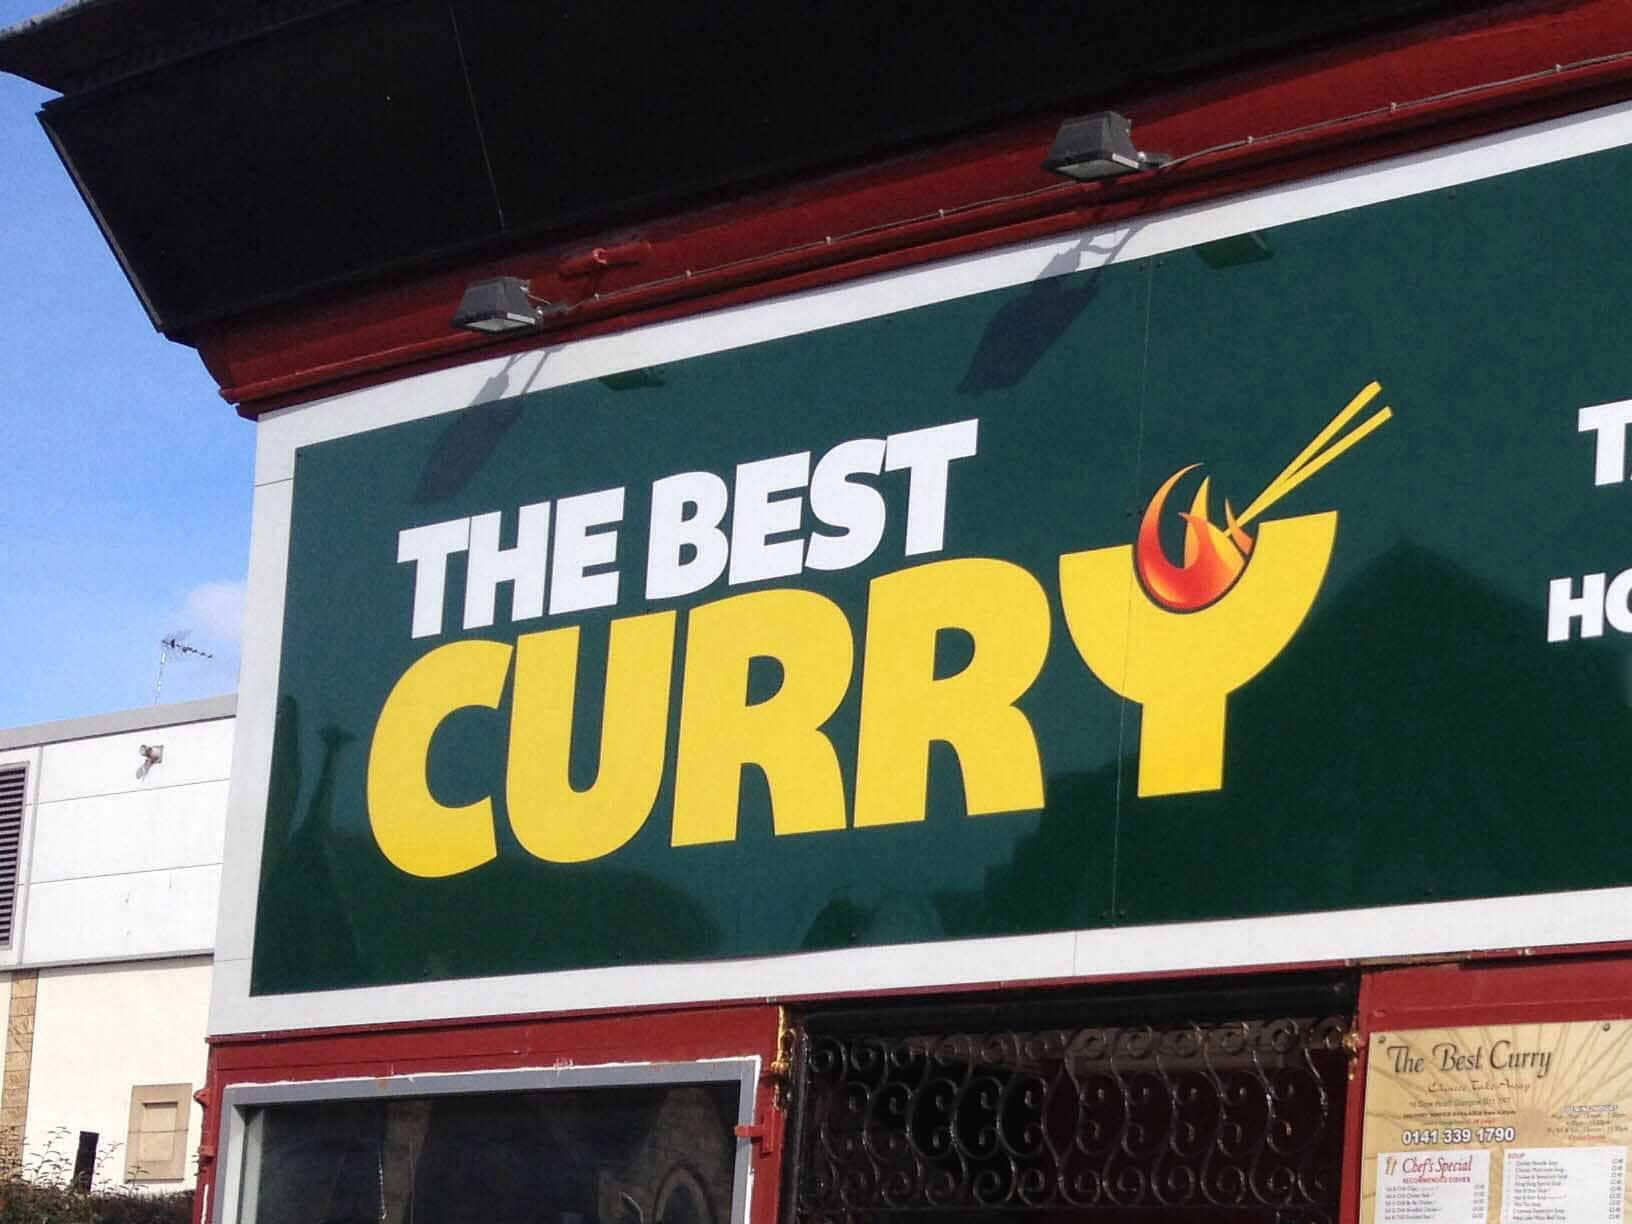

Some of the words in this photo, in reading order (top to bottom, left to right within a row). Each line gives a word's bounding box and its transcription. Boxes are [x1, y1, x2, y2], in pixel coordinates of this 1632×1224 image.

[397, 487, 626, 639] THE
[645, 418, 980, 600] BEST
[366, 509, 1339, 878] CURRY
[1387, 1046, 1424, 1073] The
[1433, 1042, 1482, 1072] Best
[1490, 1040, 1552, 1078] Curry
[1402, 1130, 1440, 1145] 0141
[1443, 1129, 1471, 1144] 339
[1477, 1127, 1515, 1142] 1790
[1402, 1156, 1433, 1177] Chef's
[1435, 1155, 1473, 1178] Special
